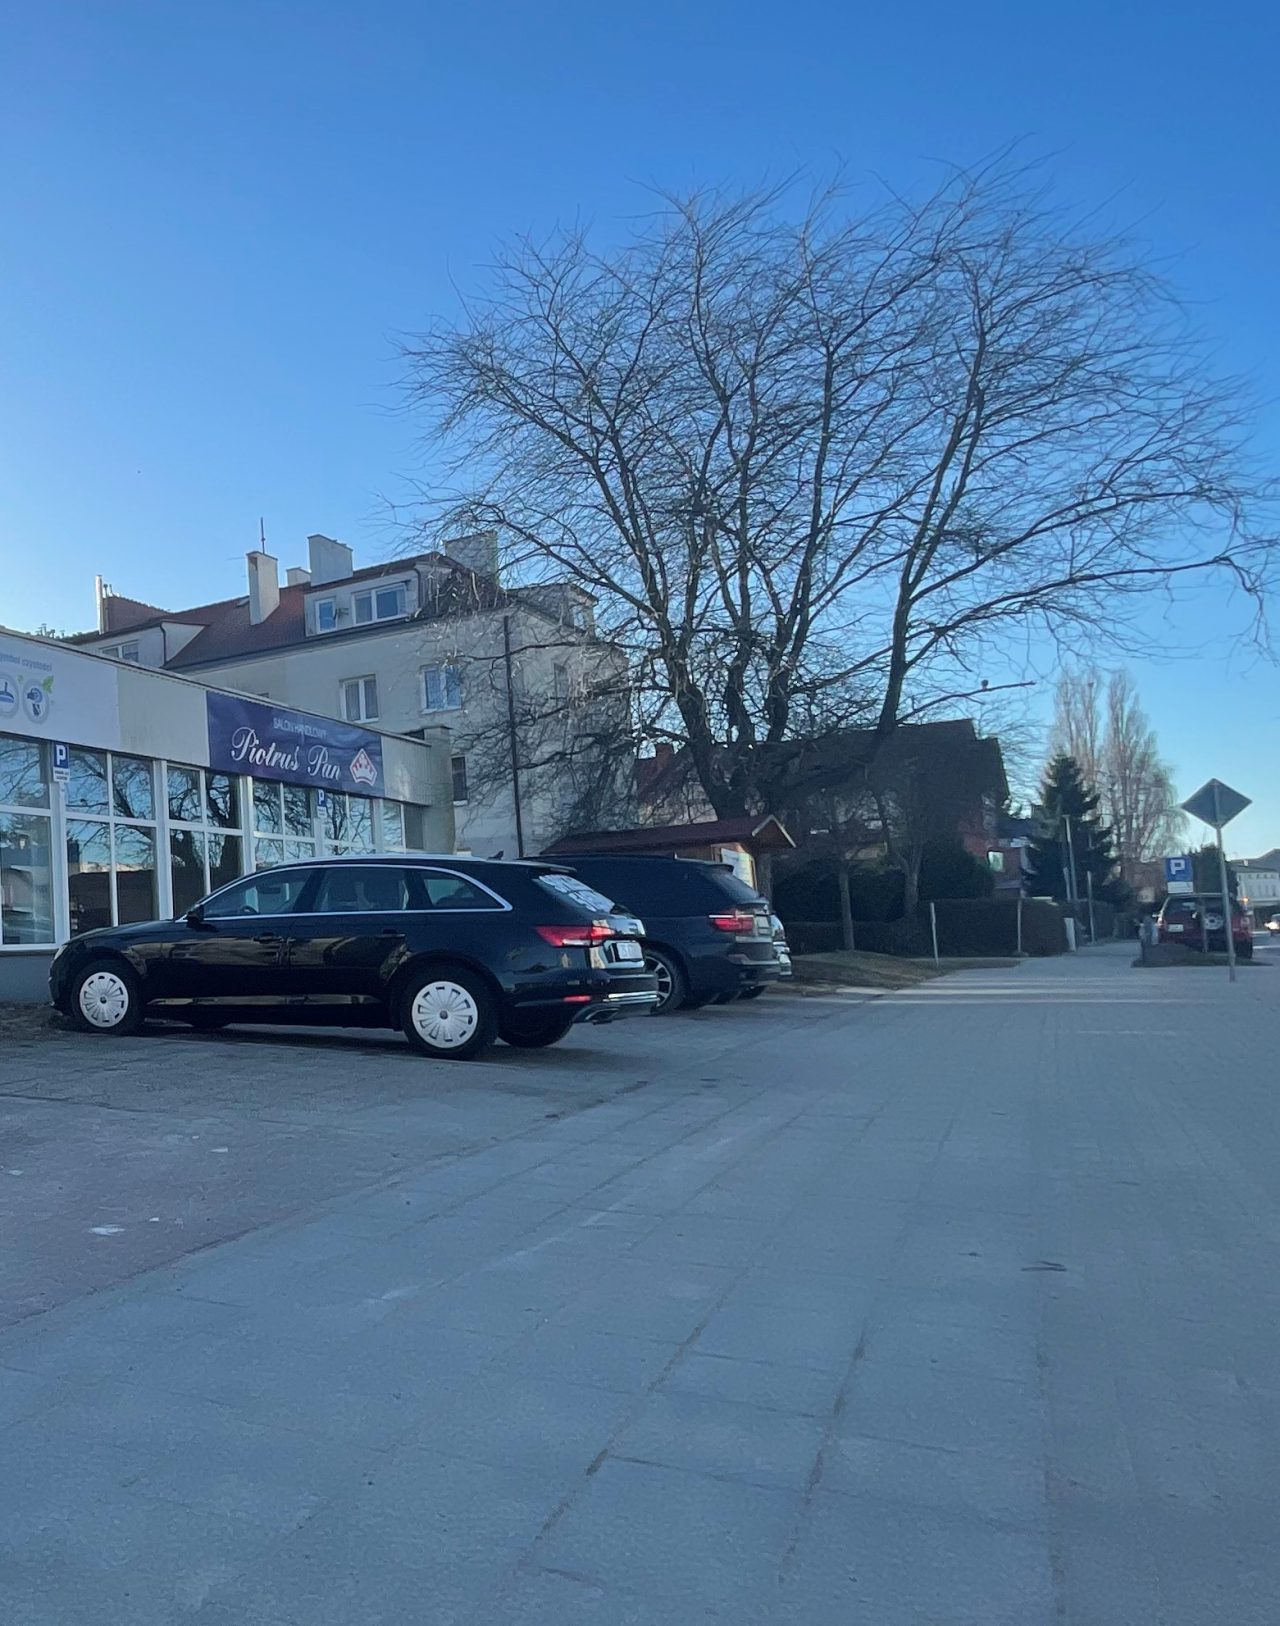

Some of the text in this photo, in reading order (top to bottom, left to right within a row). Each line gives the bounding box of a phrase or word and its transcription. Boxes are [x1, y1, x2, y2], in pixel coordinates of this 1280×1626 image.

[56, 744, 67, 766] P
[231, 726, 342, 781] Piotruś Pan
[318, 789, 325, 805] P
[1169, 858, 1186, 875] P
